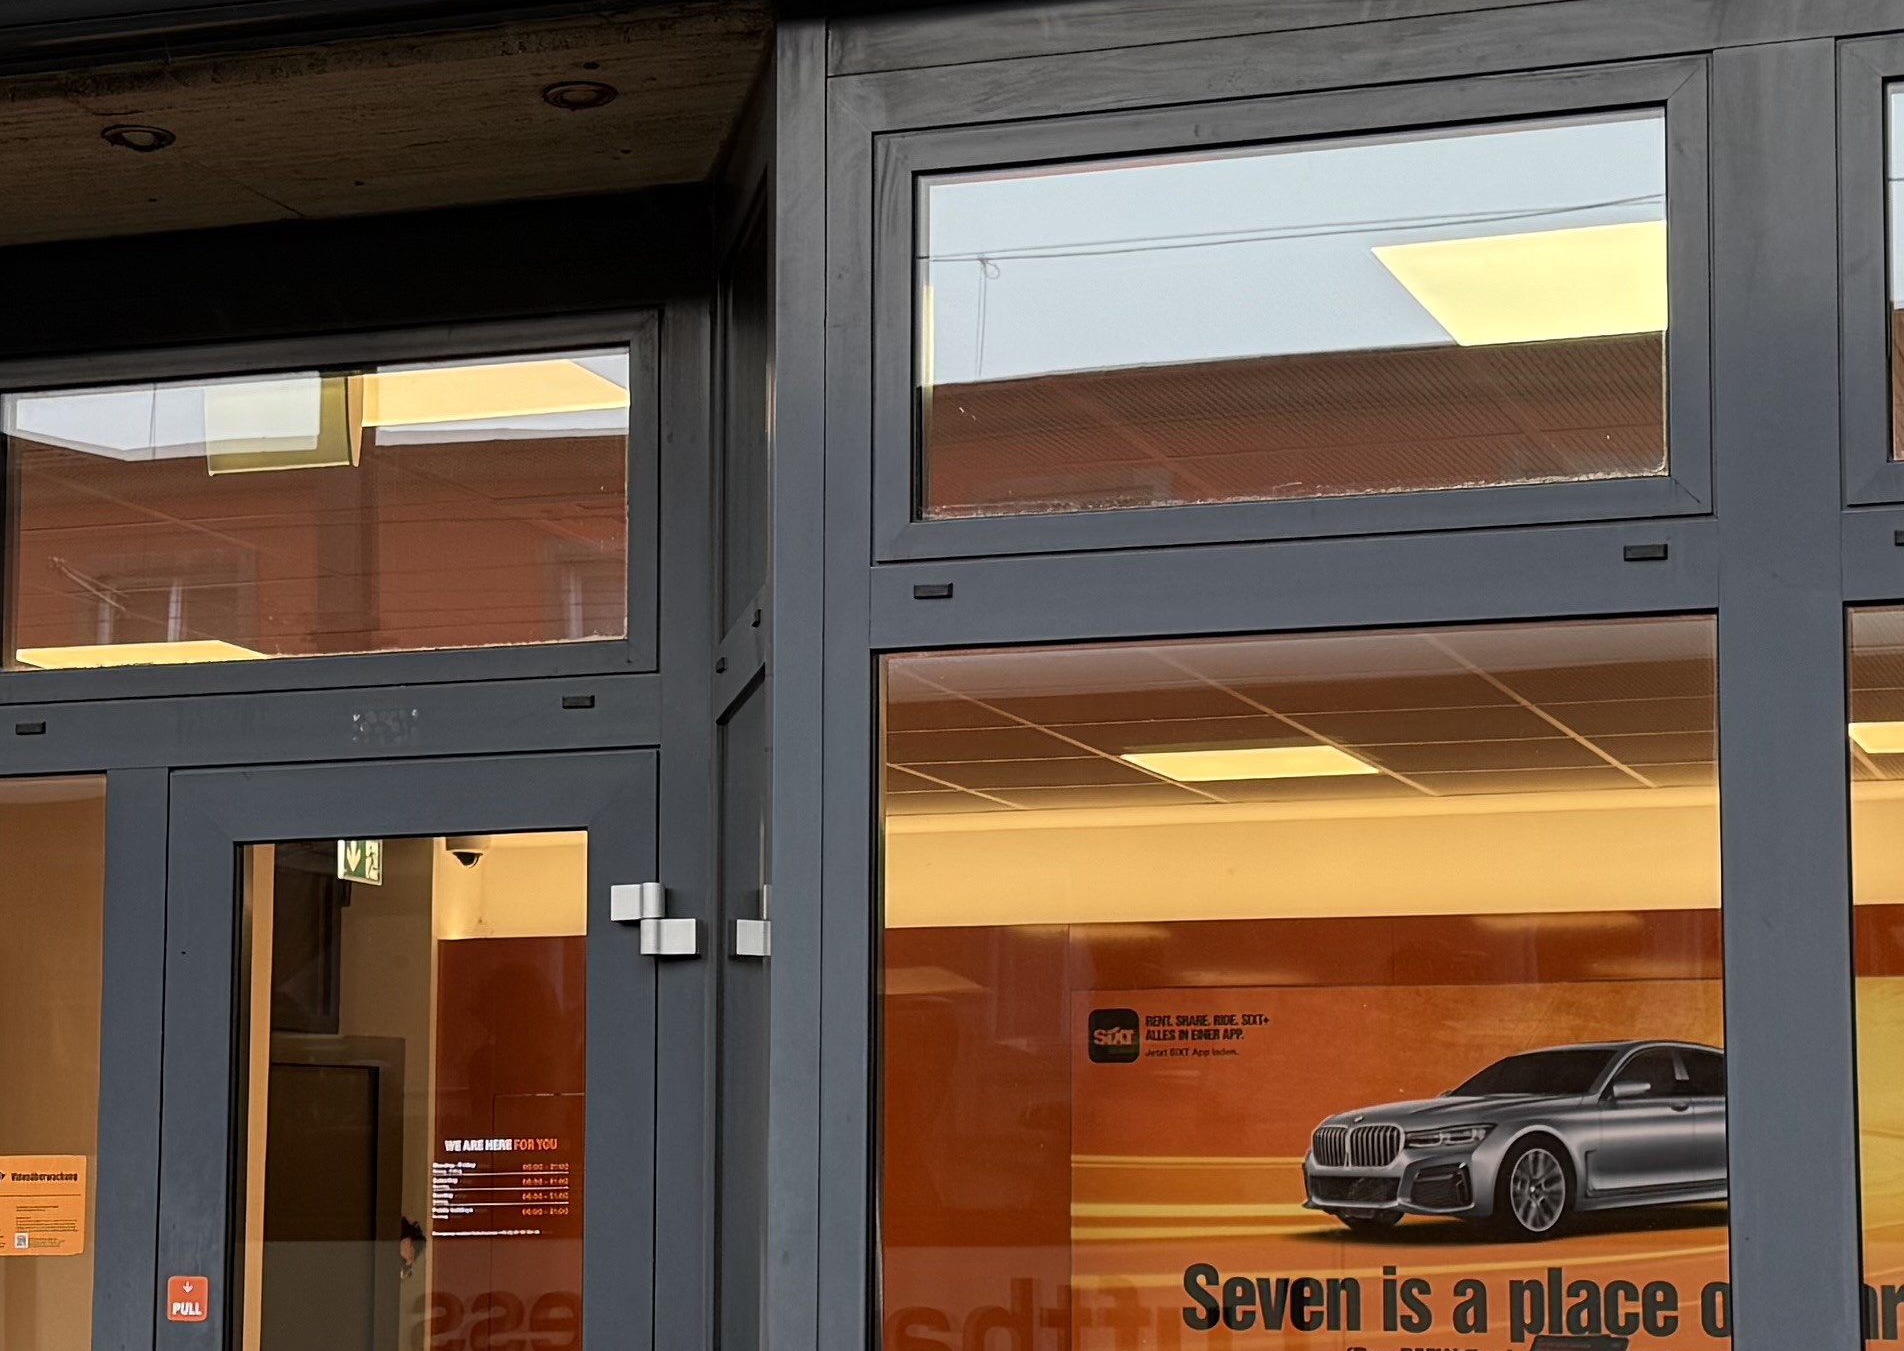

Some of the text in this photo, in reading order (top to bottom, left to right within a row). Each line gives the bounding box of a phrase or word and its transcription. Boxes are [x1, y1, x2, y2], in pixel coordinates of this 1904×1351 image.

[1145, 1015, 1172, 1027] RENT.
[1176, 1014, 1210, 1027] SHARE.
[1145, 1028, 1244, 1041] ALLES IN EINER APP.
[444, 1138, 558, 1151] WE ARE HERE FOR YOU
[172, 1301, 203, 1316] PULL
[1181, 1262, 1362, 1333] Seven
[1382, 1266, 1433, 1334] is
[1452, 1278, 1488, 1334] a
[1508, 1267, 1681, 1342] place
